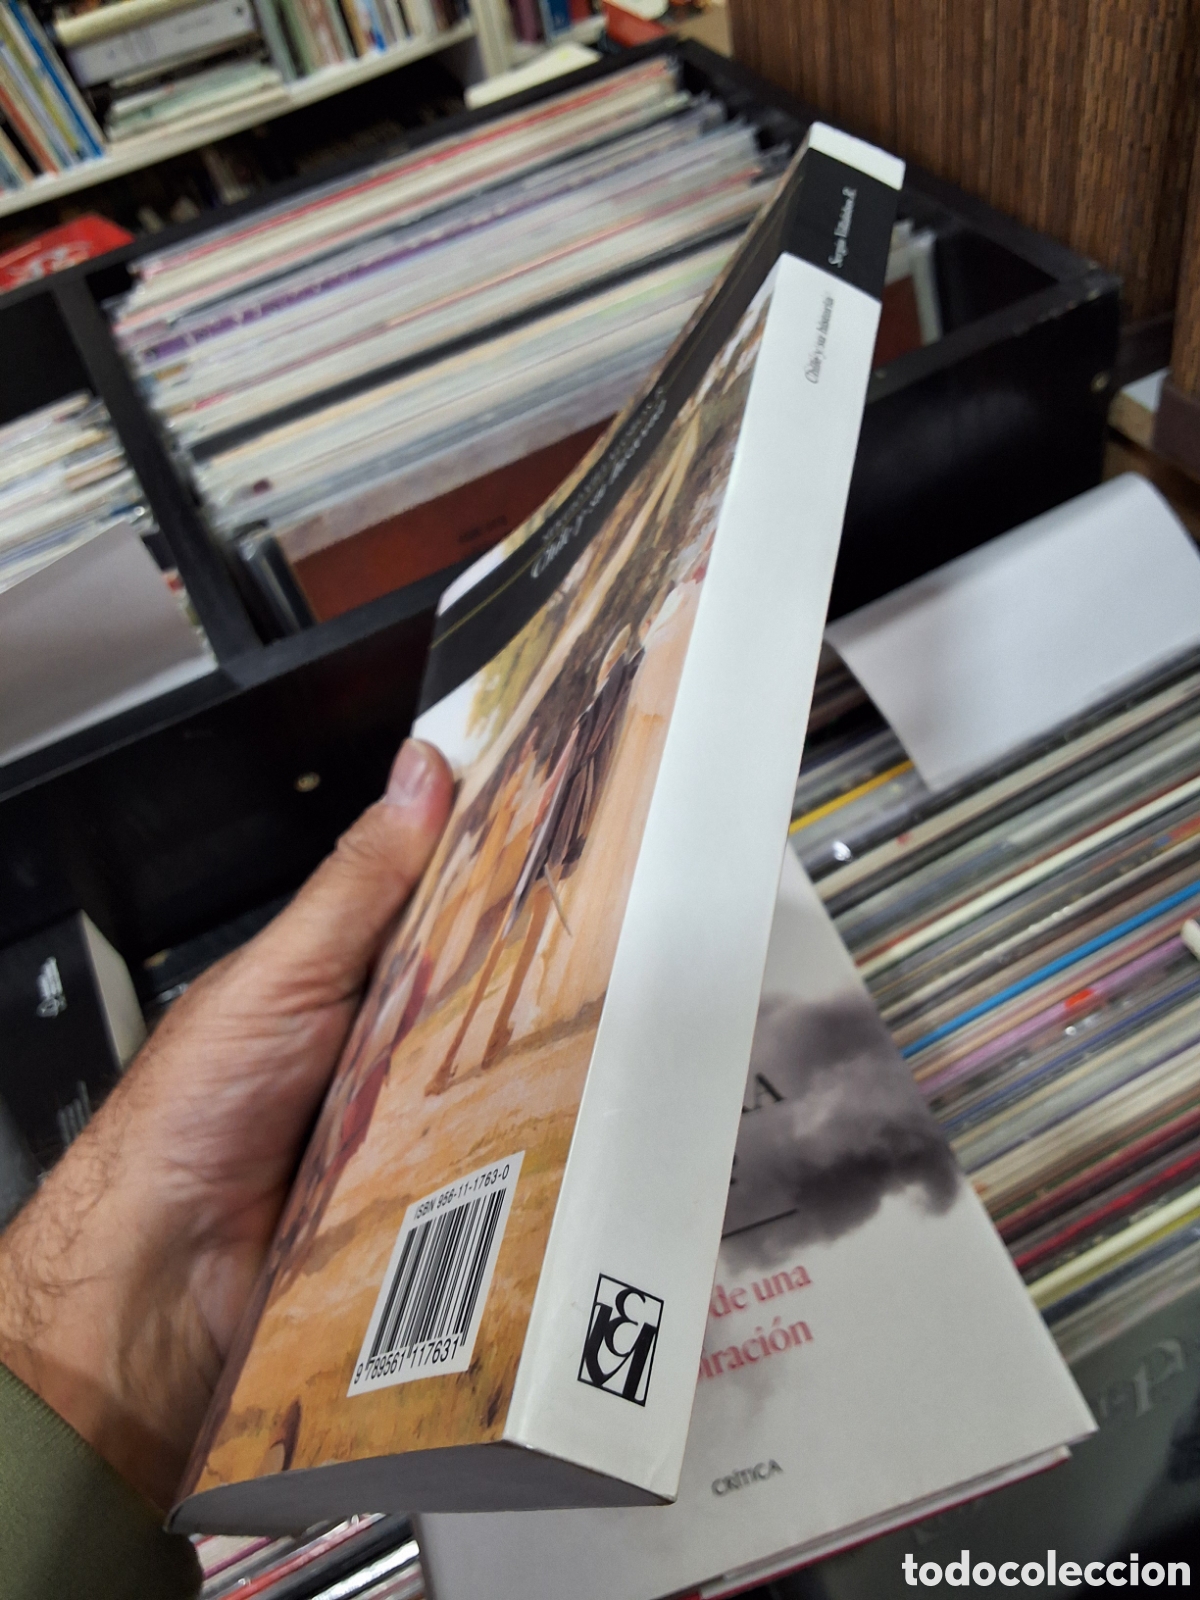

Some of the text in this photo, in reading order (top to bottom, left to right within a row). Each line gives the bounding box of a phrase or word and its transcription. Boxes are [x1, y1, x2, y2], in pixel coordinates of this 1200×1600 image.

[414, 1164, 510, 1220] ISBN 956-11-1763-0
[710, 1264, 812, 1318] de una
[699, 1315, 814, 1380] iración
